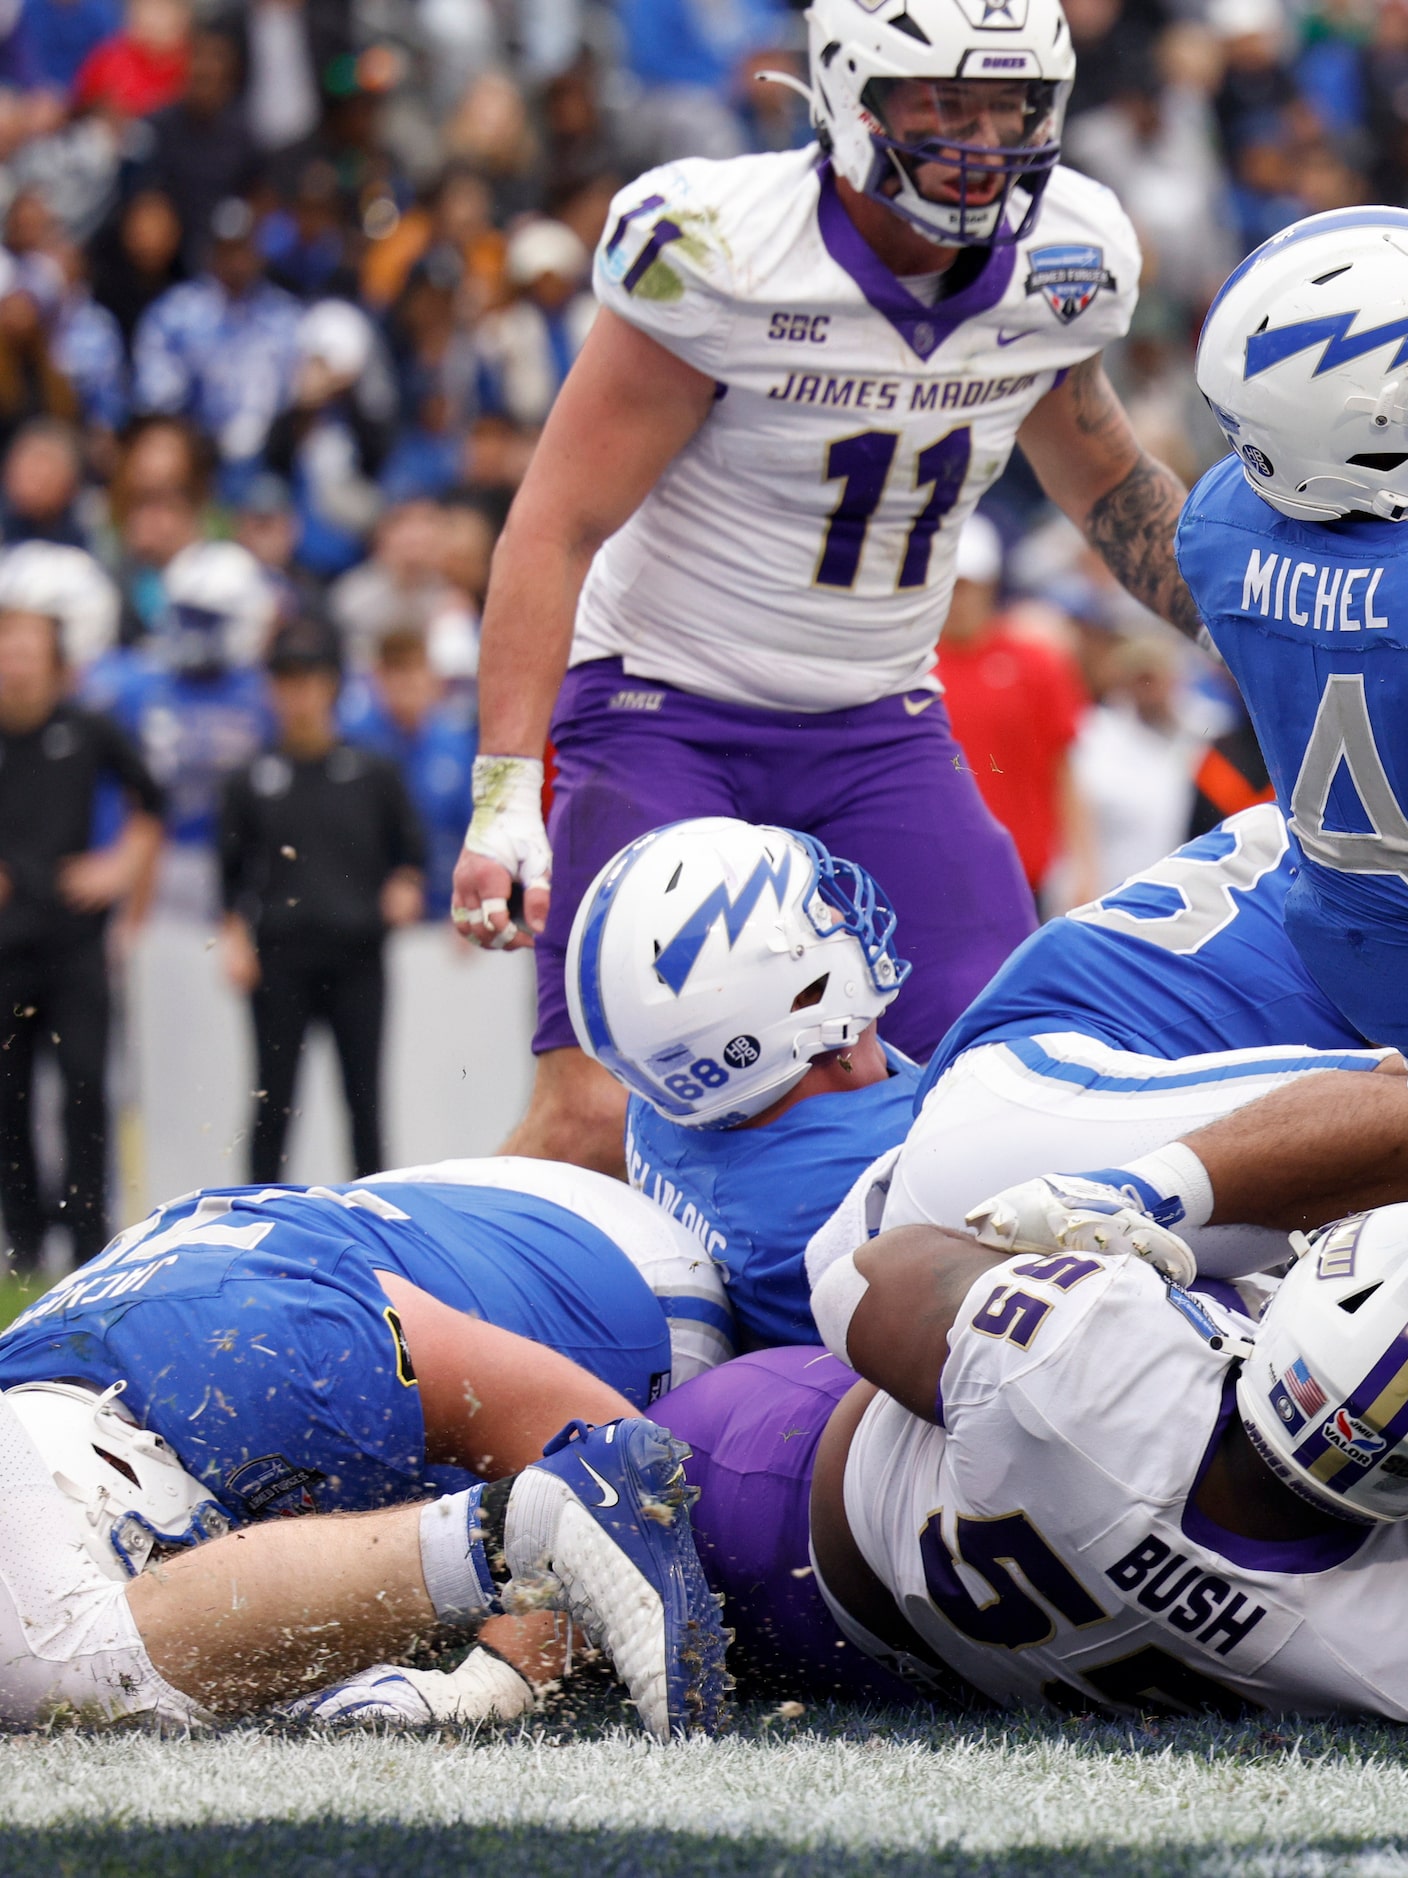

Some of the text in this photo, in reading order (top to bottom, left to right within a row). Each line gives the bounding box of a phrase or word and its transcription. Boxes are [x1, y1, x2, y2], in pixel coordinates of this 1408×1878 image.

[982, 57, 1027, 70] DUKES
[768, 312, 831, 344] SBC
[768, 370, 1038, 413] JAMES MADISON
[812, 422, 974, 594] 11
[1240, 548, 1389, 632] MICHEL
[726, 1036, 749, 1059] HB
[735, 1046, 758, 1068] 79
[664, 1057, 730, 1101] 68
[1325, 1425, 1371, 1466] VALOR
[1349, 1419, 1375, 1440] JMU
[1106, 1533, 1267, 1656] BUSH
